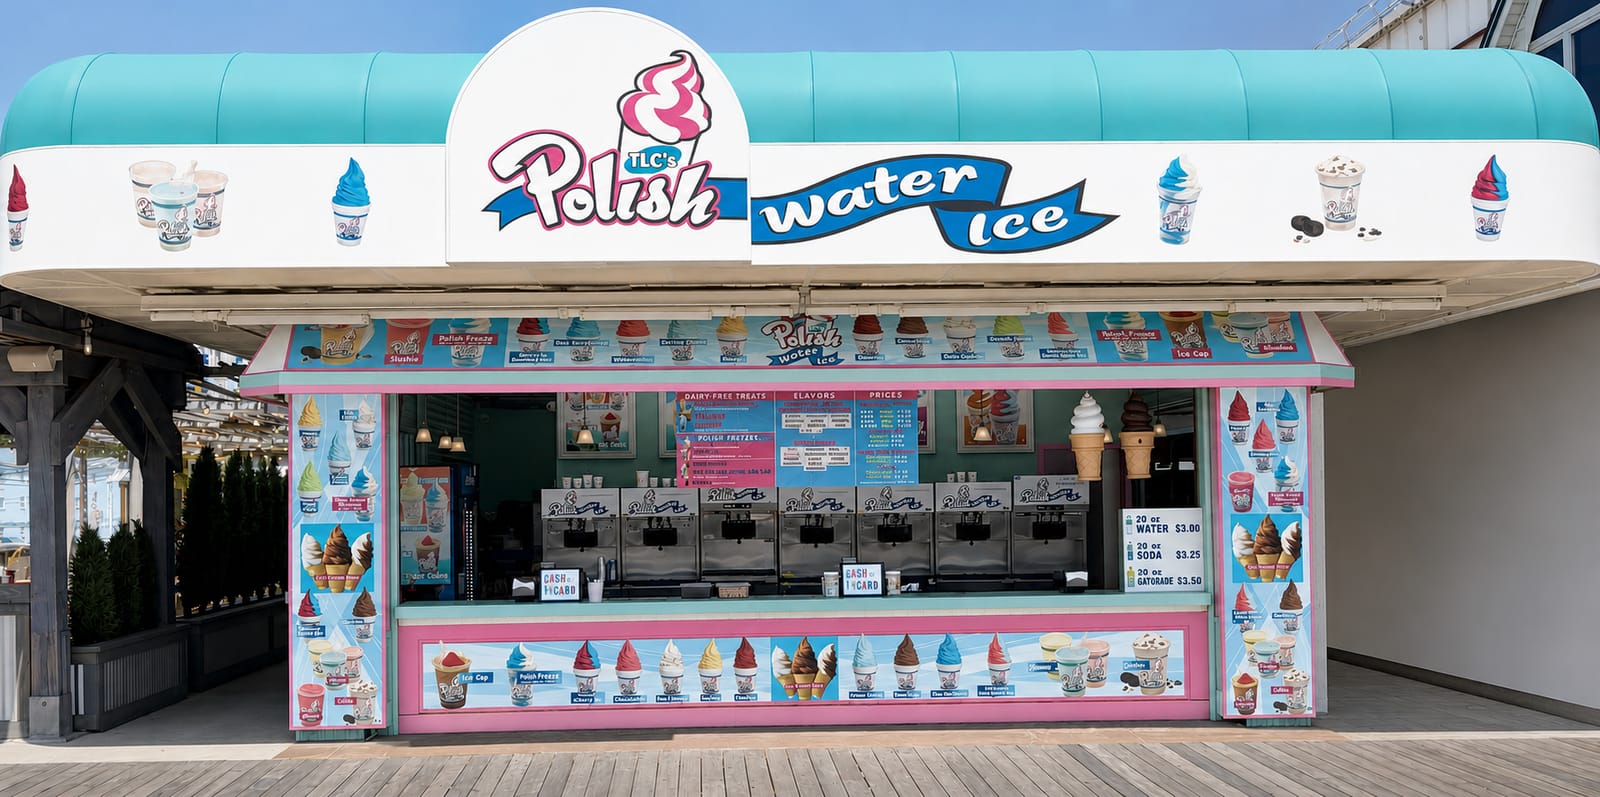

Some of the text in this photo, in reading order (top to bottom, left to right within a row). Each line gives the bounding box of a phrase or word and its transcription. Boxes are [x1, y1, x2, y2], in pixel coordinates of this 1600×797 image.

[628, 152, 678, 169] TLC's
[489, 130, 719, 230] Polish
[759, 165, 1069, 246] Water Ice
[1136, 515, 1147, 523] 20
[1136, 524, 1200, 533] WATER $3.00
[1137, 542, 1148, 550] 20
[1137, 550, 1201, 560] SODA $3.25
[544, 574, 566, 584] CASH
[1138, 576, 1202, 586] GATORADE $3.50
[857, 581, 879, 590] CARD
